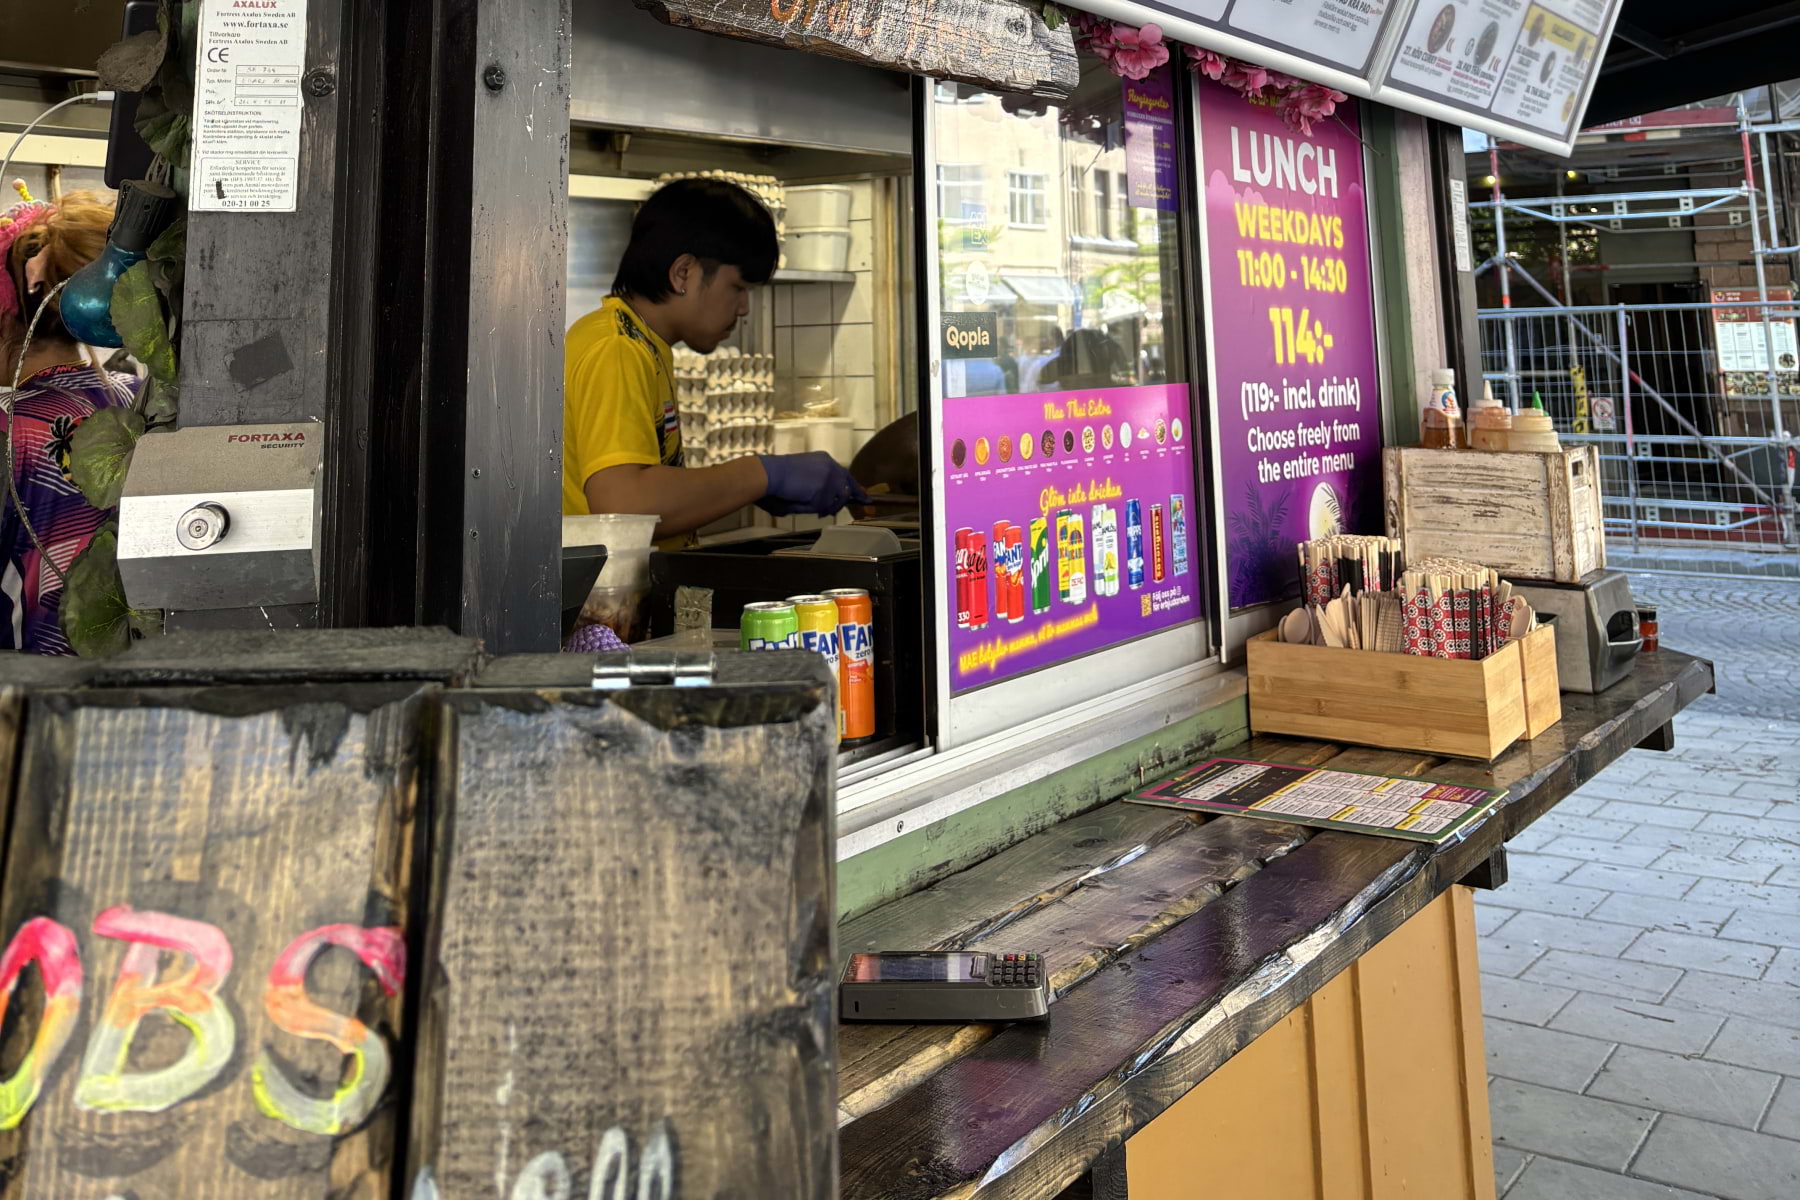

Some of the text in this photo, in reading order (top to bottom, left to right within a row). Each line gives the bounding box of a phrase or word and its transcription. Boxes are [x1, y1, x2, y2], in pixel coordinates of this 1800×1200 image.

[207, 47, 229, 63] CE
[1230, 126, 1338, 199] LUNCH
[1234, 201, 1344, 250] WEEKDAYS
[1237, 249, 1348, 294] 11:00 14:30
[946, 327, 990, 351] Qopla
[1268, 307, 1334, 365] 114:-
[1282, 378, 1316, 410] incl.
[1318, 376, 1360, 412] drink)
[228, 432, 305, 443] FORTAXA
[1247, 419, 1360, 452] Choose freely from
[1257, 451, 1354, 484] the entire menu
